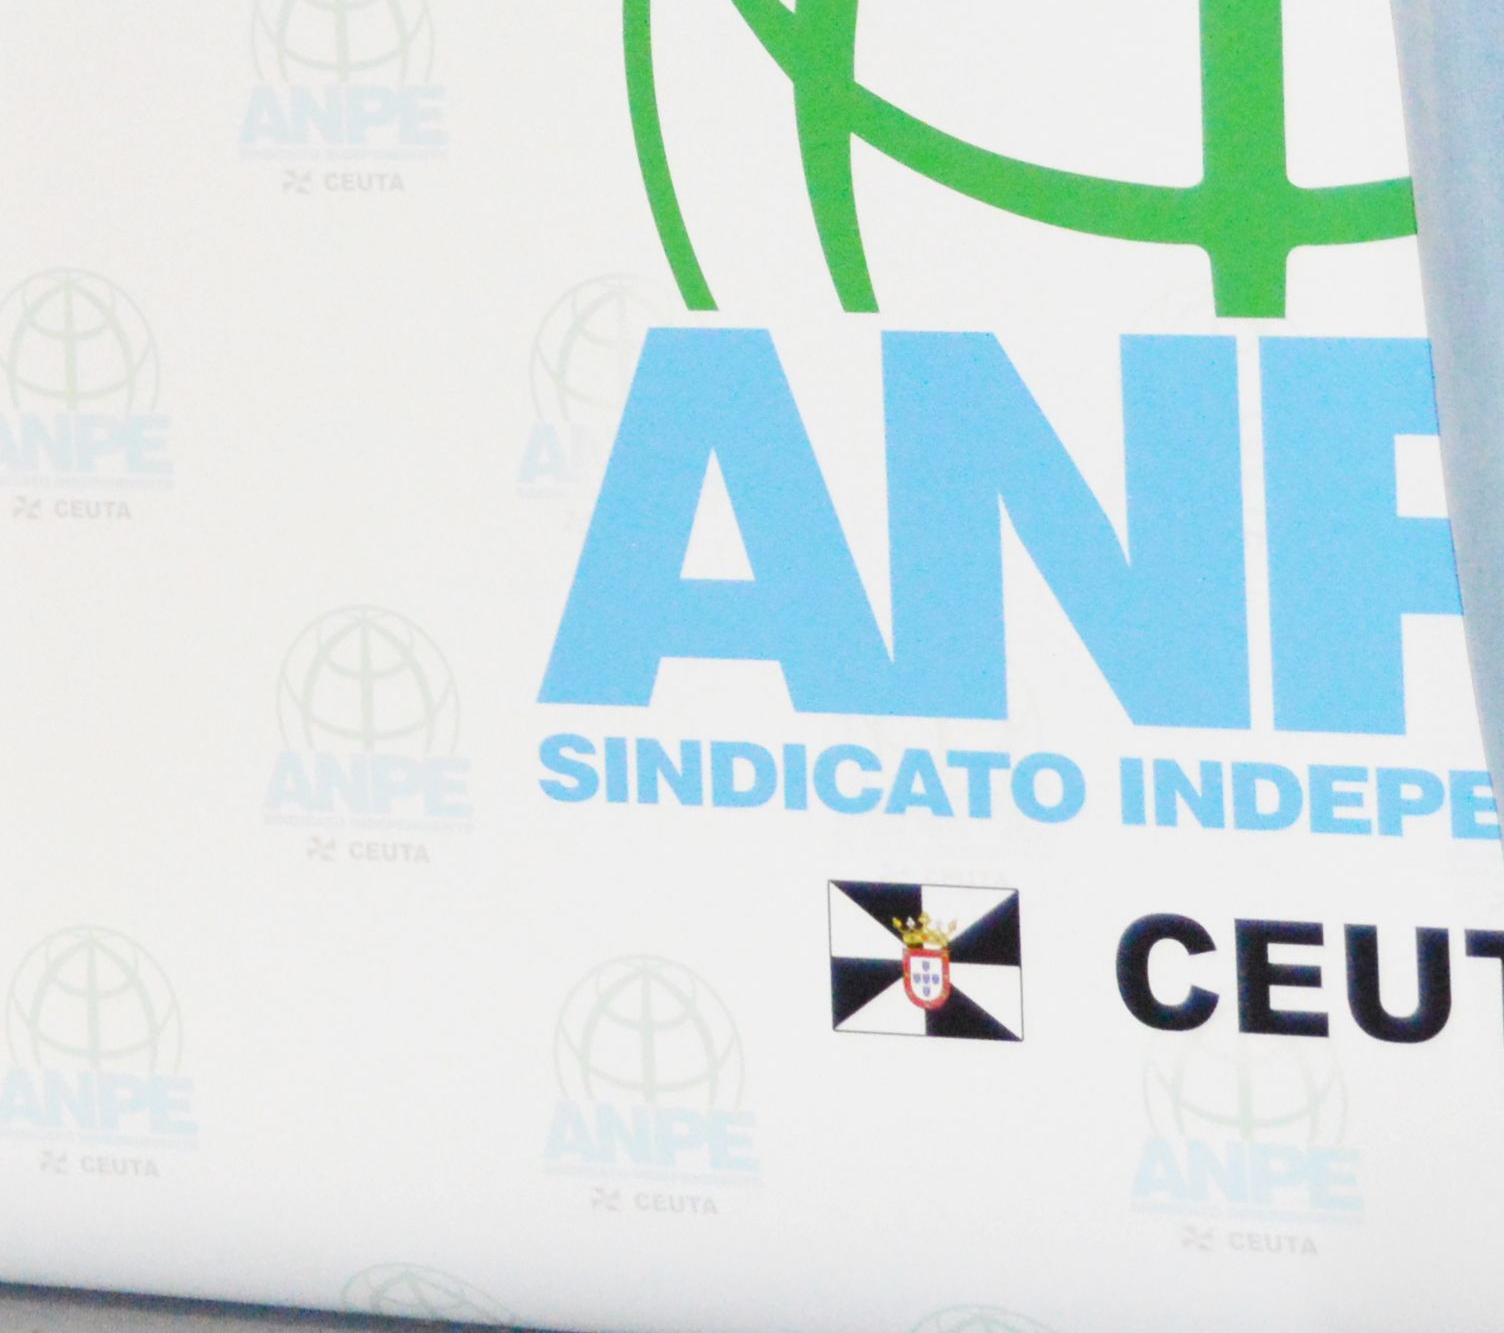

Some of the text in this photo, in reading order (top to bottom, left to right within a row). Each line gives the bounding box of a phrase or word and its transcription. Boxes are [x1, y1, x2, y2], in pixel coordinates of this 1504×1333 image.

[238, 85, 449, 145] ANPE
[324, 172, 405, 192] CEUTA
[54, 500, 132, 520] CEUTA
[263, 748, 474, 819] ANPE
[536, 732, 1087, 824] SINDICATO
[349, 841, 431, 863] CEUTA
[544, 1100, 760, 1173] ANPE
[81, 1154, 160, 1178] CEUTA
[1130, 1136, 1364, 1211] ANPE
[634, 1191, 718, 1216] CEUTA
[1228, 1232, 1318, 1256] CEUTA
